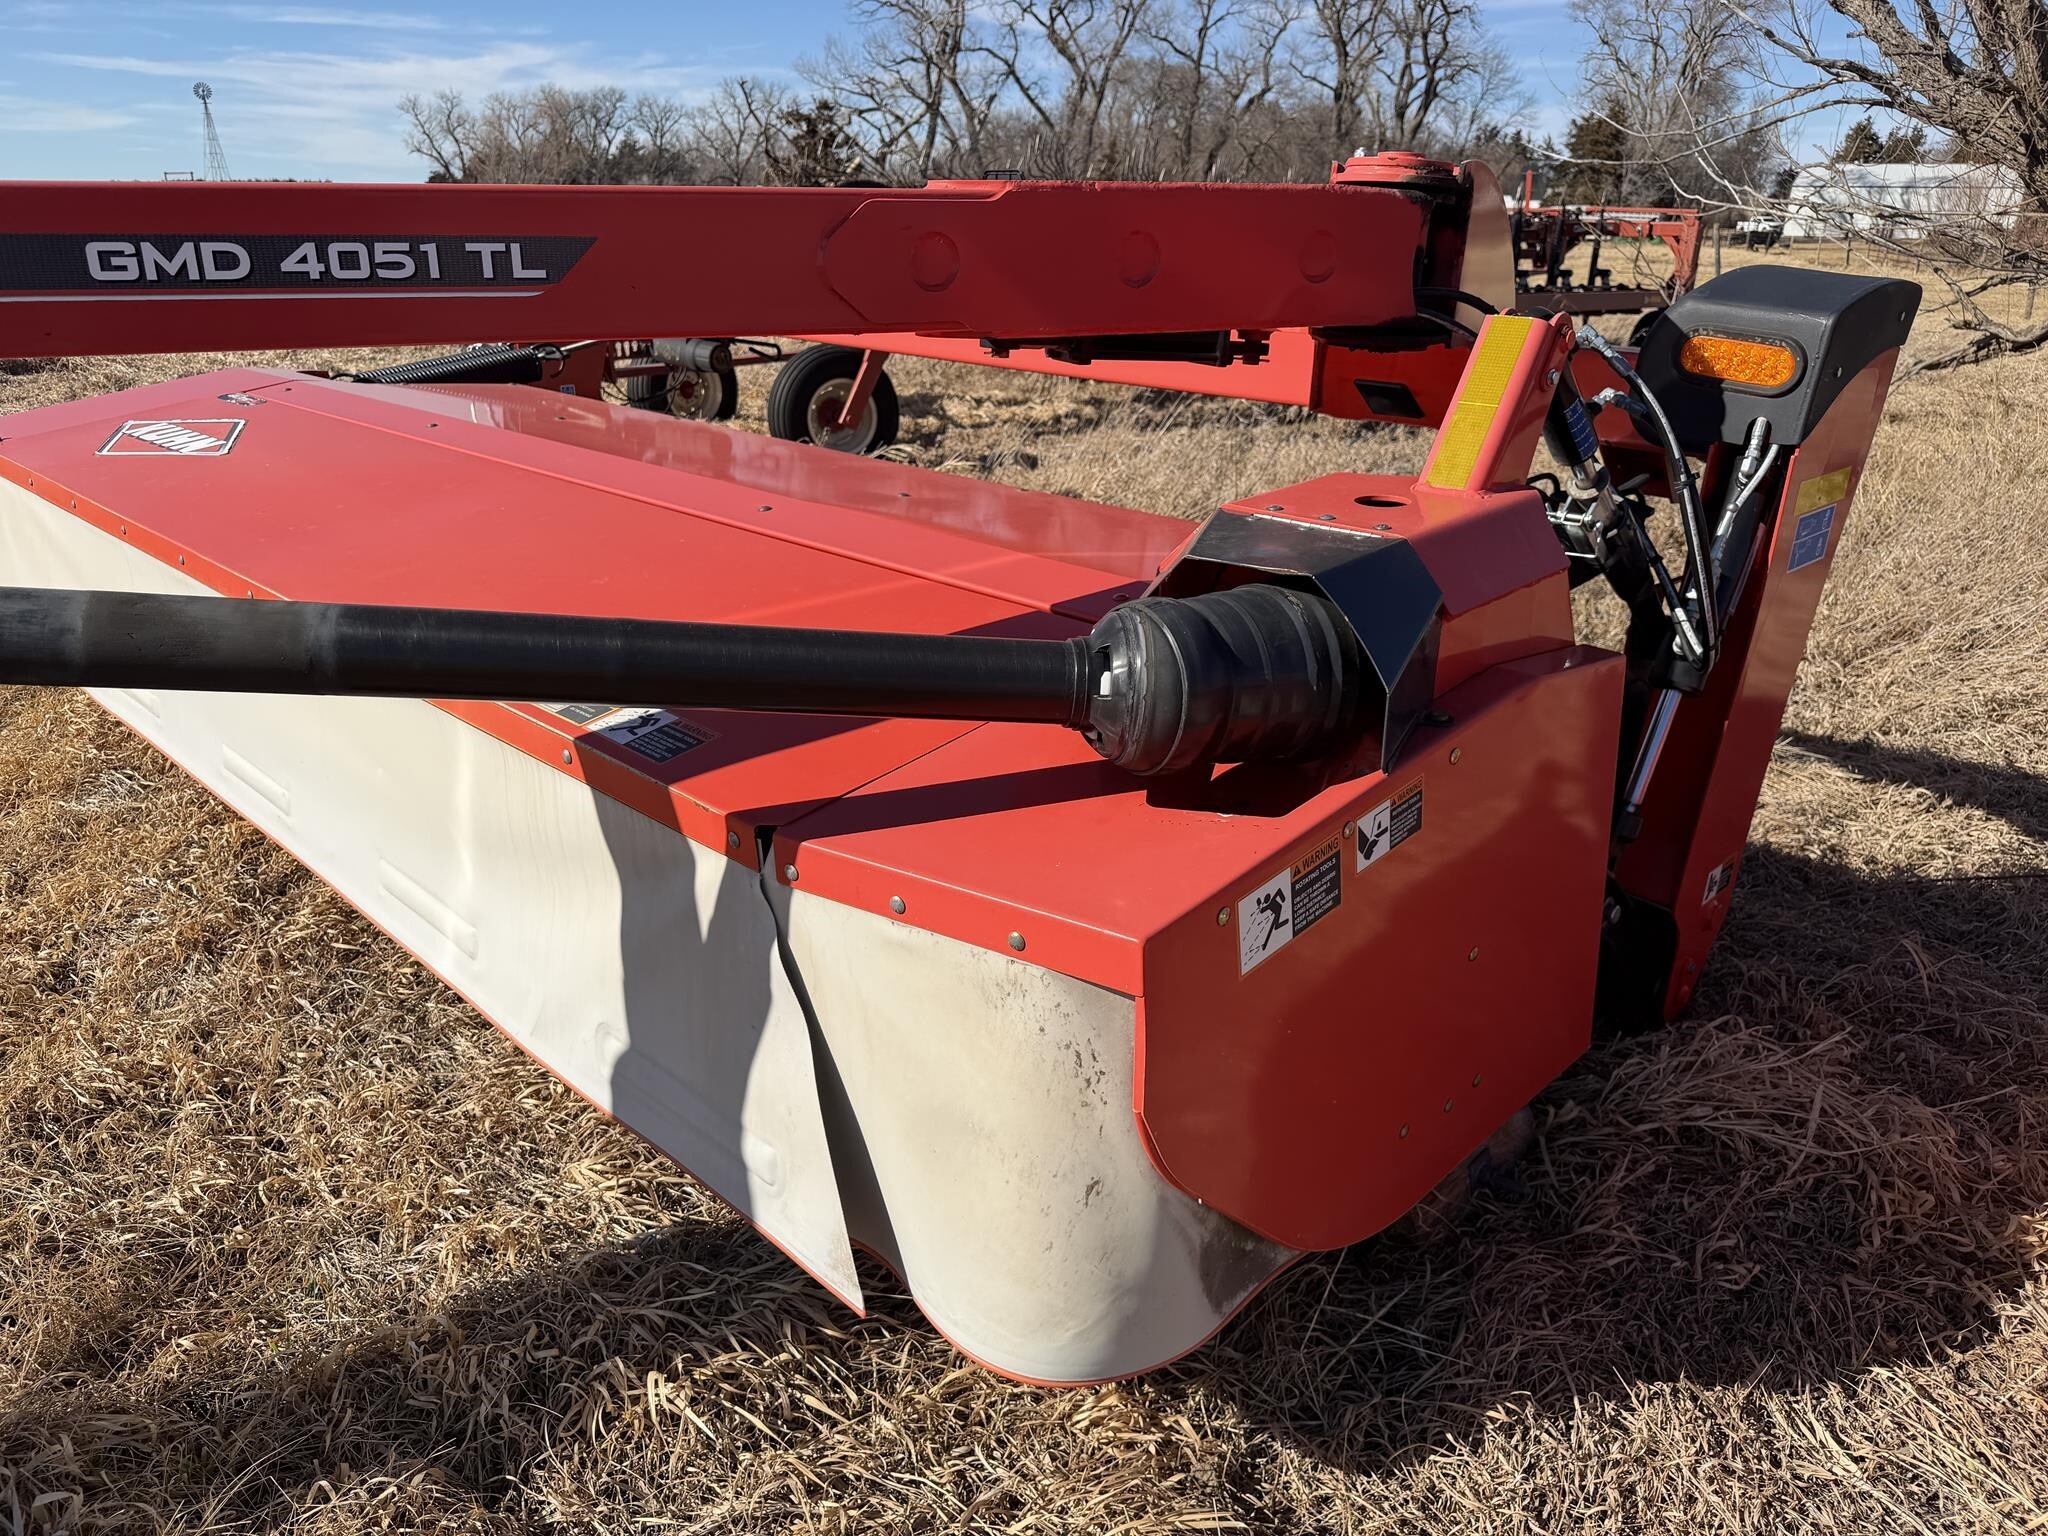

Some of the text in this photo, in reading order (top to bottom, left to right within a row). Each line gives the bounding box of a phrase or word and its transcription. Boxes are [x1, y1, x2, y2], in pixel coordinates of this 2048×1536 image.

[85, 241, 547, 281] GMD 4051 TL
[121, 422, 228, 453] KUHN
[1302, 838, 1339, 871] WARNING
[1295, 857, 1336, 891] ROTATING TOOLS
